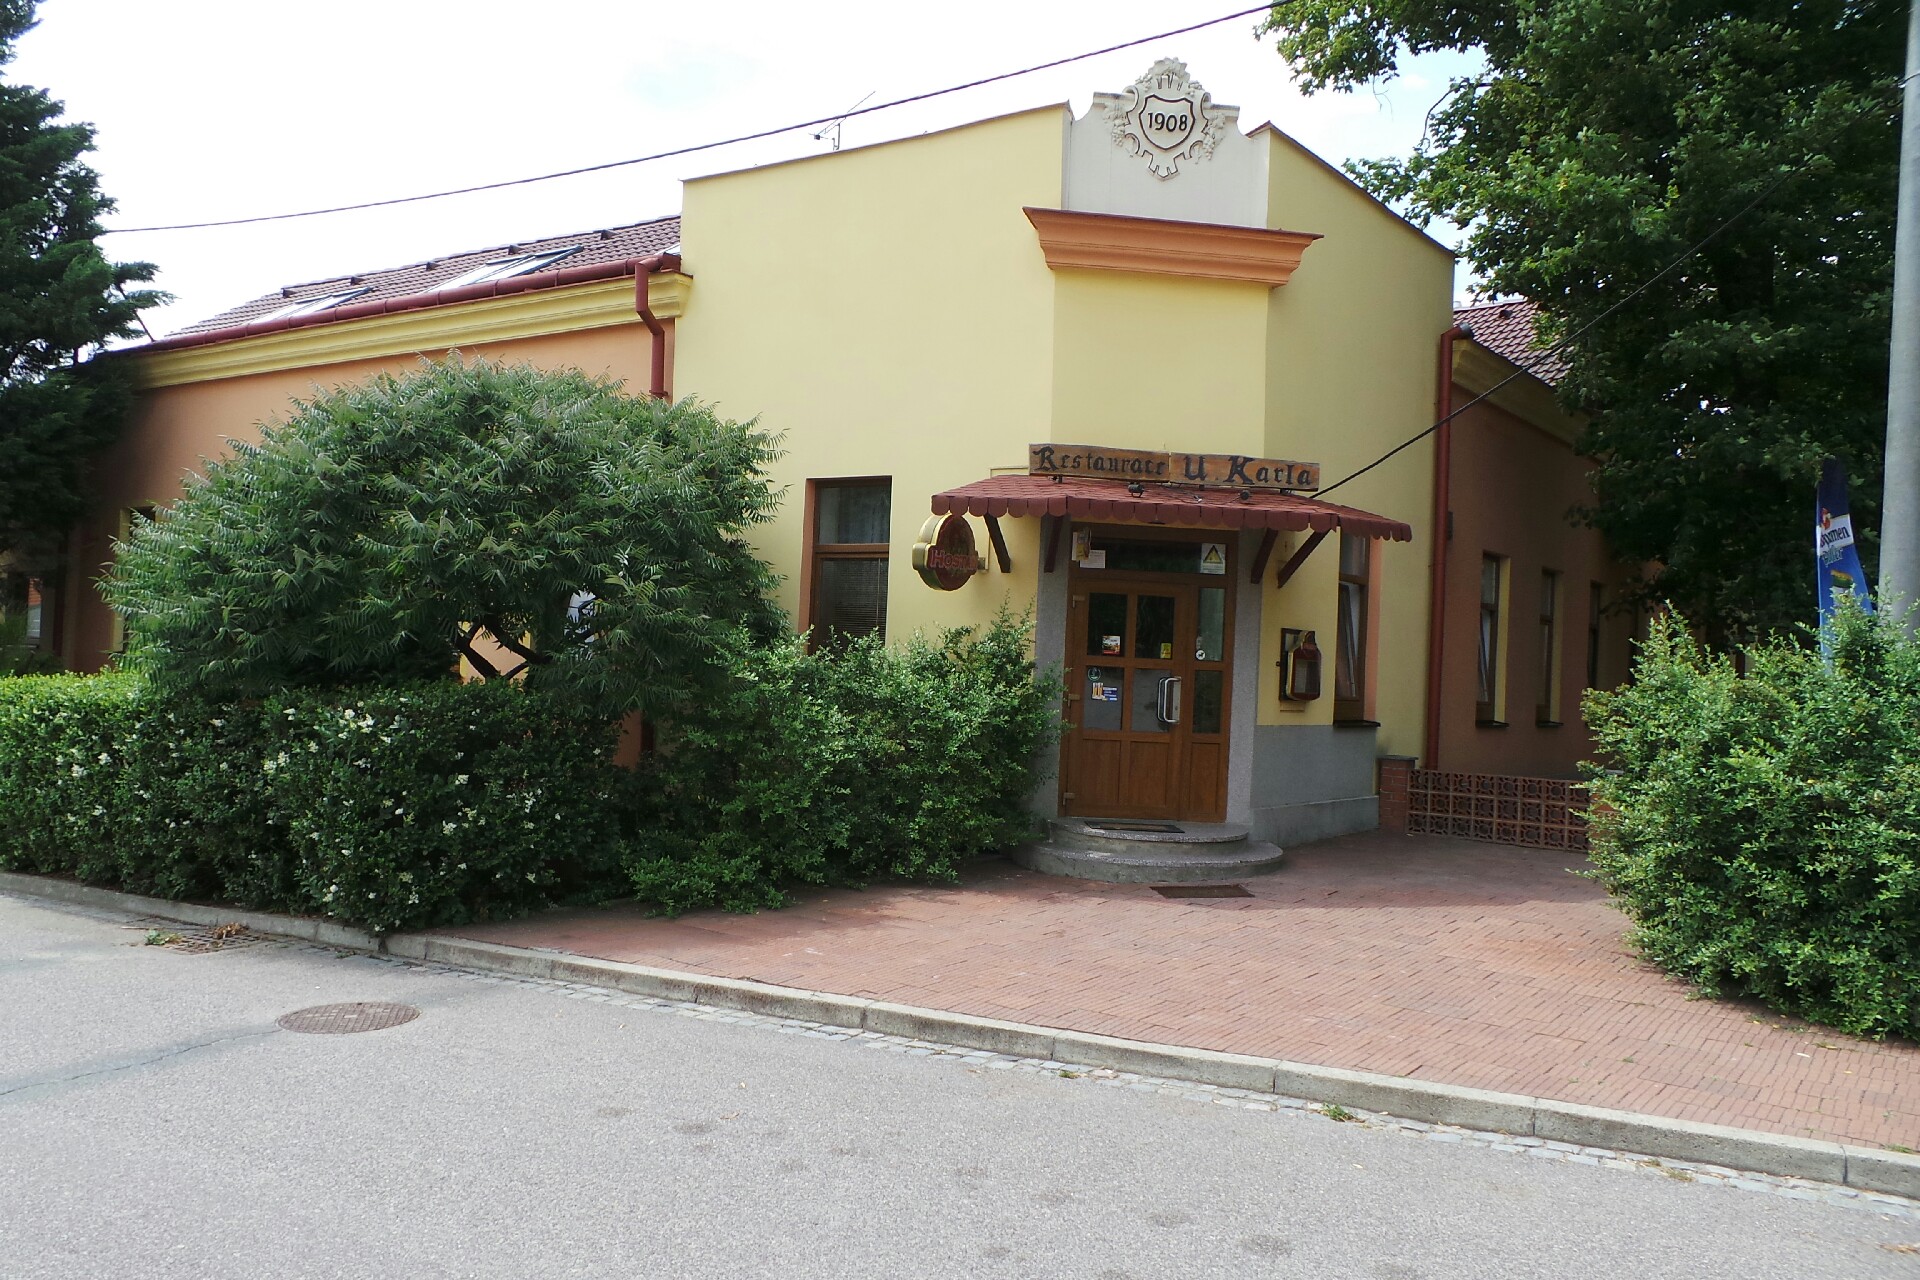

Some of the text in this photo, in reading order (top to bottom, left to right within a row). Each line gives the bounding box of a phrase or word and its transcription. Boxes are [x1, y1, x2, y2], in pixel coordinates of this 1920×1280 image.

[1147, 112, 1188, 132] 1908
[1032, 445, 1312, 486] Restaurace U Karla
